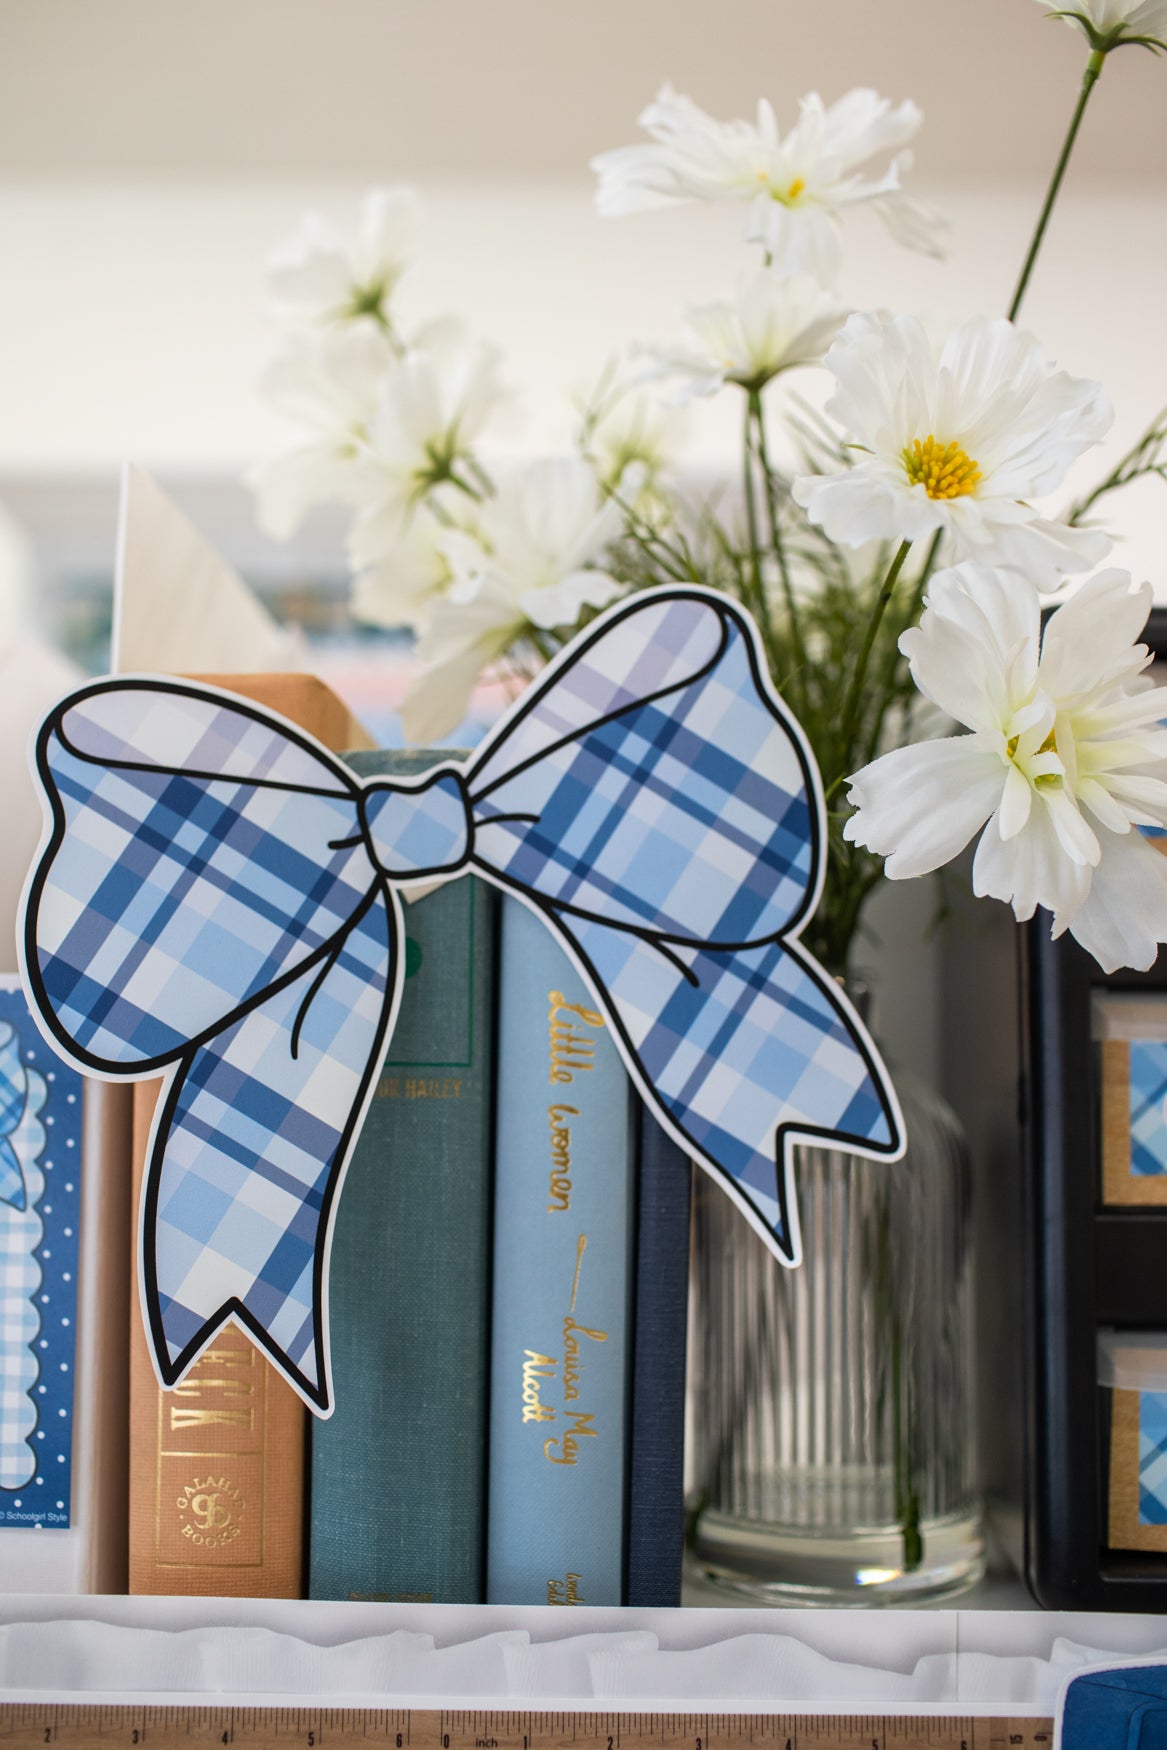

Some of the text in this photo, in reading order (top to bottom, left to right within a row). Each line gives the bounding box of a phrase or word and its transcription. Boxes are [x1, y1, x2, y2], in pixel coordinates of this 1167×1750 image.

[548, 990, 605, 1085] Little
[521, 1349, 558, 1424] Alcott
[543, 1316, 608, 1465] Louisa May
[6, 1511, 46, 1523] Schoolgirl
[47, 1512, 68, 1523] Style
[181, 1523, 241, 1549] BOOKS
[44, 1728, 403, 1748] 2 3 4 5 6
[443, 1734, 450, 1749] 0
[475, 1737, 498, 1749] inch
[523, 1735, 530, 1750] 1
[607, 1736, 614, 1750] 2
[695, 1737, 702, 1750] 3
